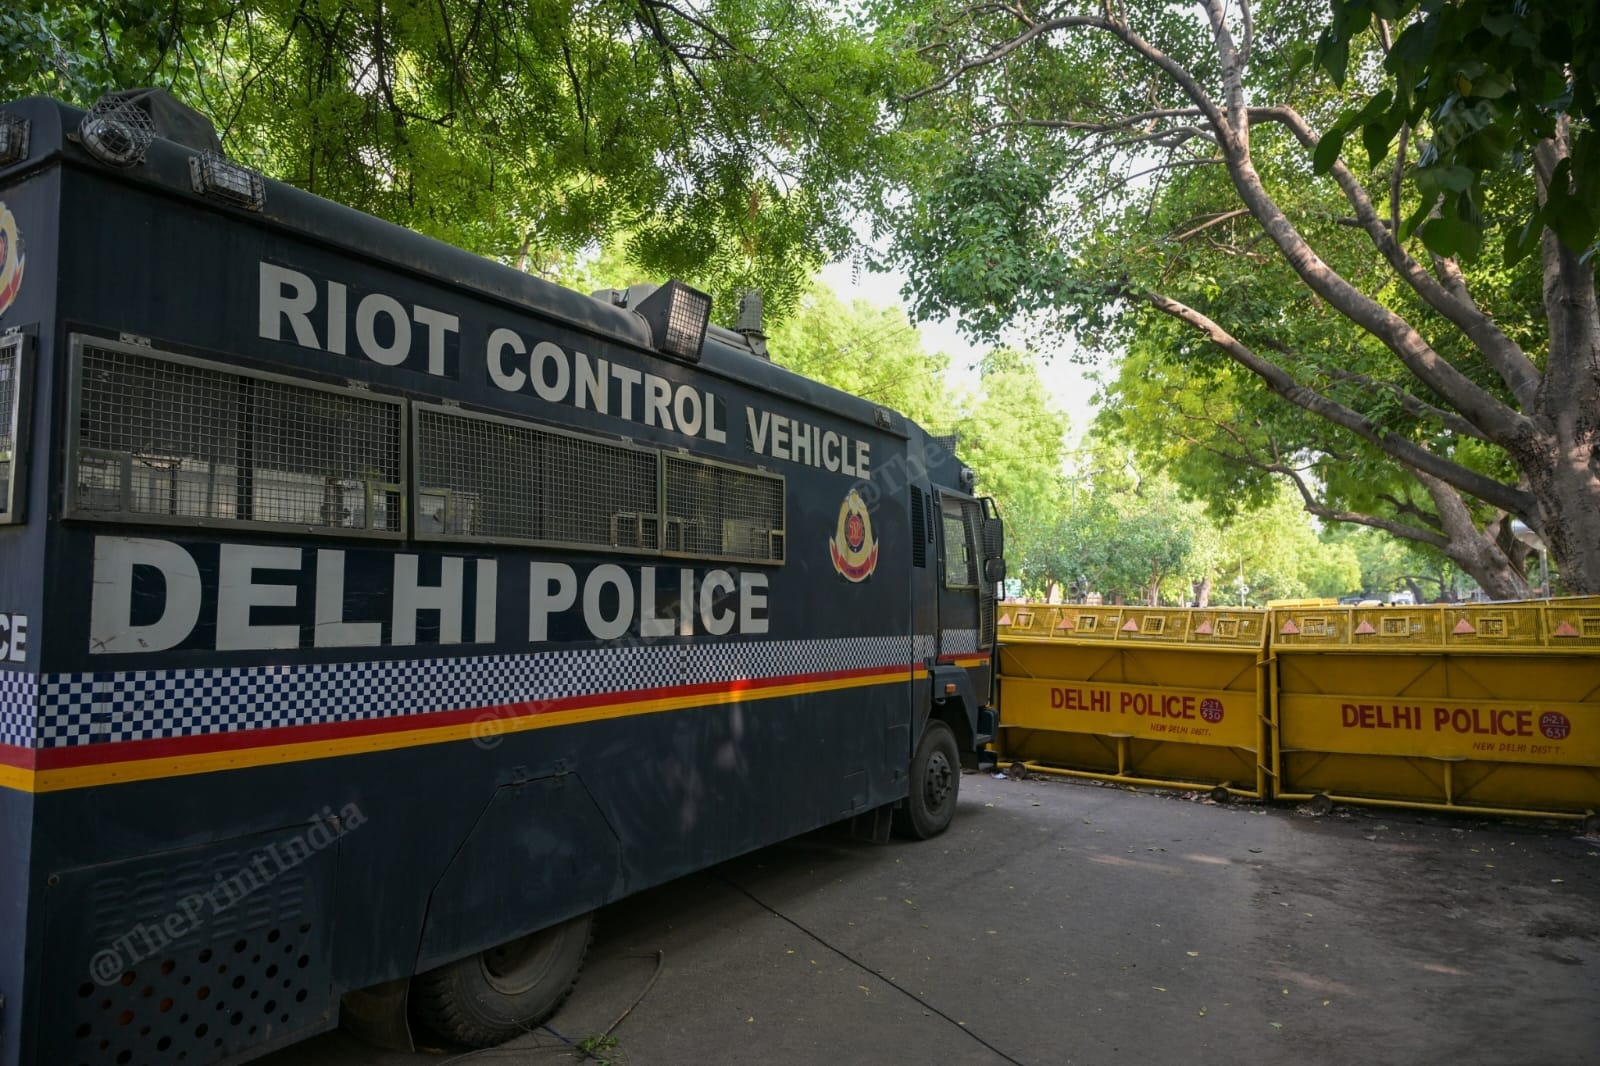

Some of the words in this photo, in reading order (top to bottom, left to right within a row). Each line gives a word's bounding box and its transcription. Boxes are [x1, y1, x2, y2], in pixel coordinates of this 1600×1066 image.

[259, 261, 459, 376] RIOT
[486, 328, 727, 443] CONTROL
[746, 406, 871, 480] VEHICLE
[89, 535, 498, 654] DELHI
[528, 561, 769, 642] POLICE
[1051, 687, 1111, 713] DELHI
[1120, 691, 1196, 720] POLICE
[1341, 703, 1422, 730] DELHI
[1434, 707, 1534, 737] POLICE
[1150, 722, 1167, 732] NEW
[1168, 725, 1189, 734] DELHI
[1472, 741, 1495, 751] NEW
[1498, 743, 1527, 753] DELHI
